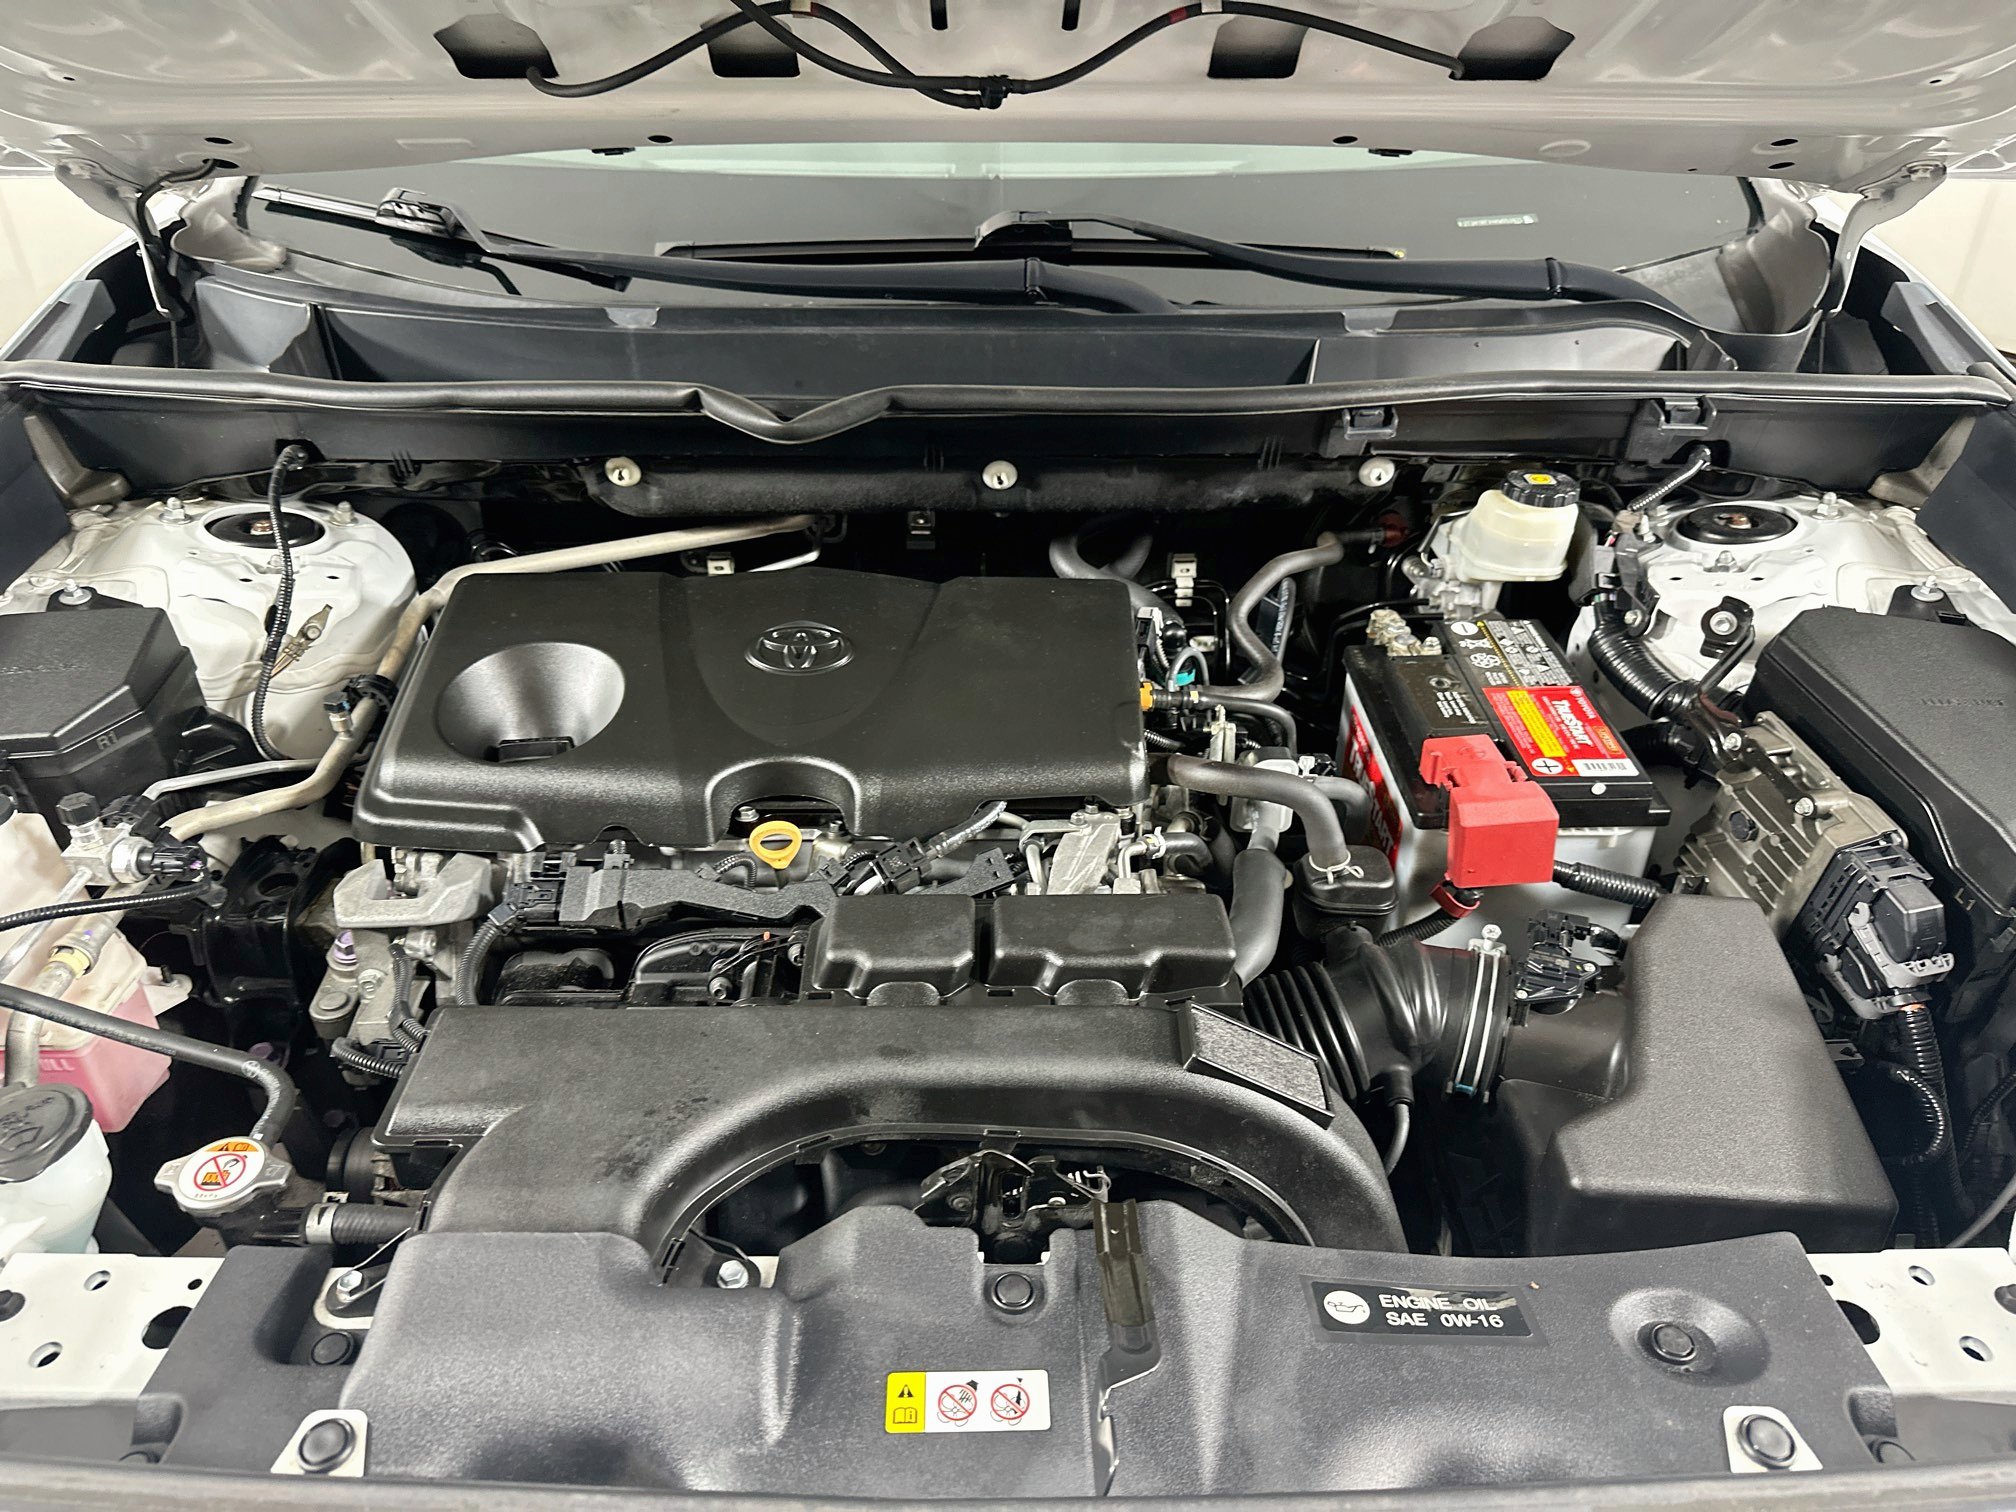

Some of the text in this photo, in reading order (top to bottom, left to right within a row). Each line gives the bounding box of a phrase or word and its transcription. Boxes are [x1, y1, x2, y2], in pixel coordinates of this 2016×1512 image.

[1576, 697, 1597, 719] TOYOTA
[96, 731, 119, 750] R1
[1954, 887, 1976, 911] L1
[1378, 1294, 1498, 1312] ENGINE OIL
[1386, 1312, 1504, 1328] SAE 0W-16
